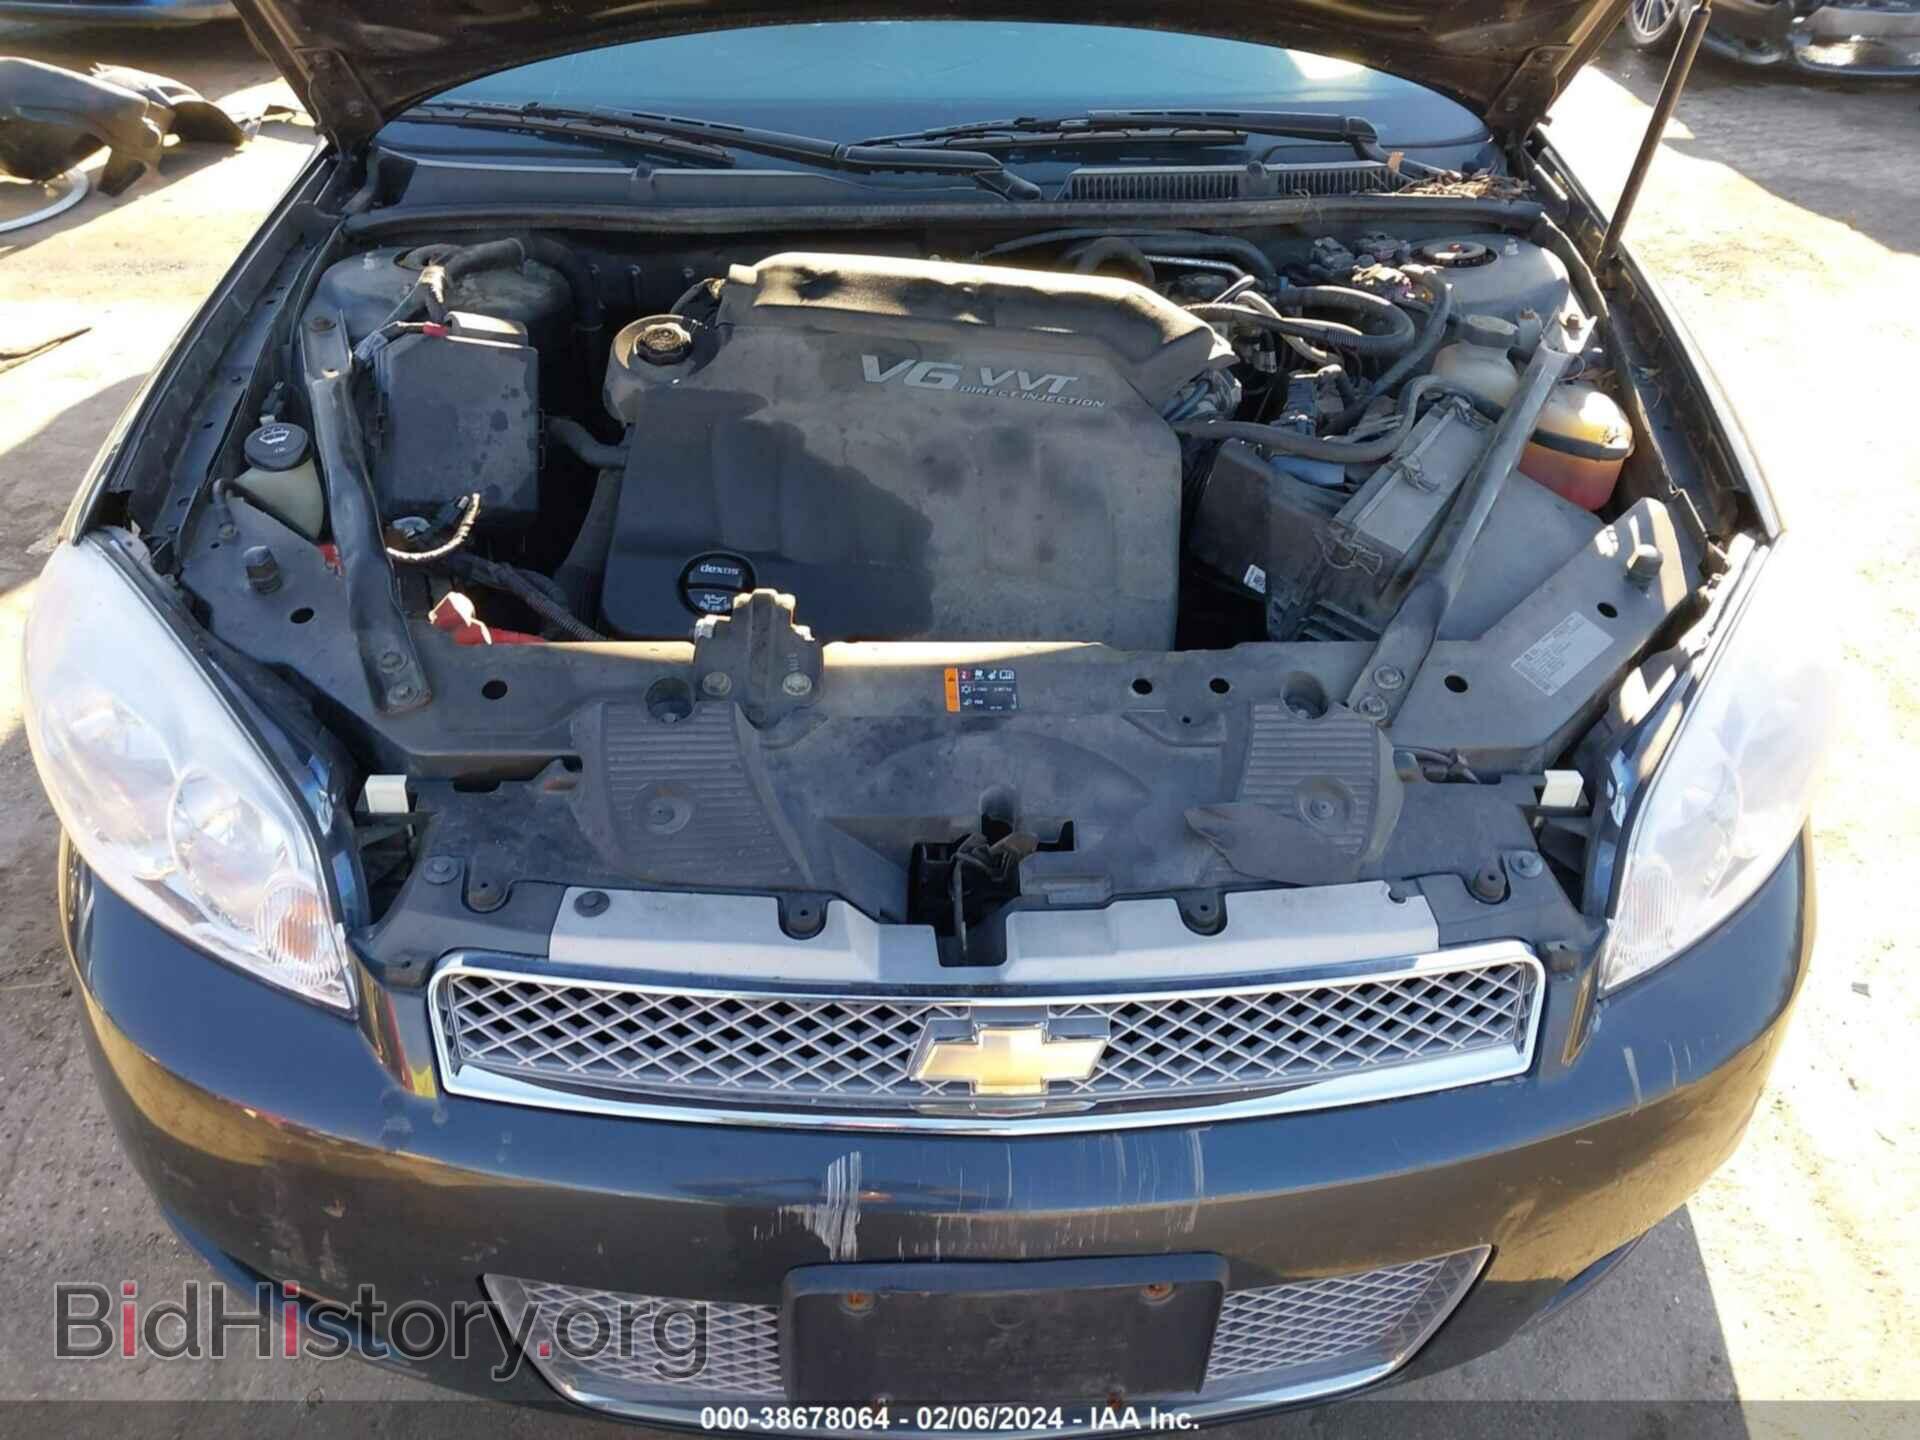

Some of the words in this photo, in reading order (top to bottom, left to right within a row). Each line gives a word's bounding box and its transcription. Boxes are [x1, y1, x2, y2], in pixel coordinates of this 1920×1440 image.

[861, 354, 962, 390] V6
[980, 367, 1078, 394] VVT
[959, 384, 1019, 399] DIRECT
[1021, 391, 1105, 408] INJECTION
[700, 563, 740, 575] dexos
